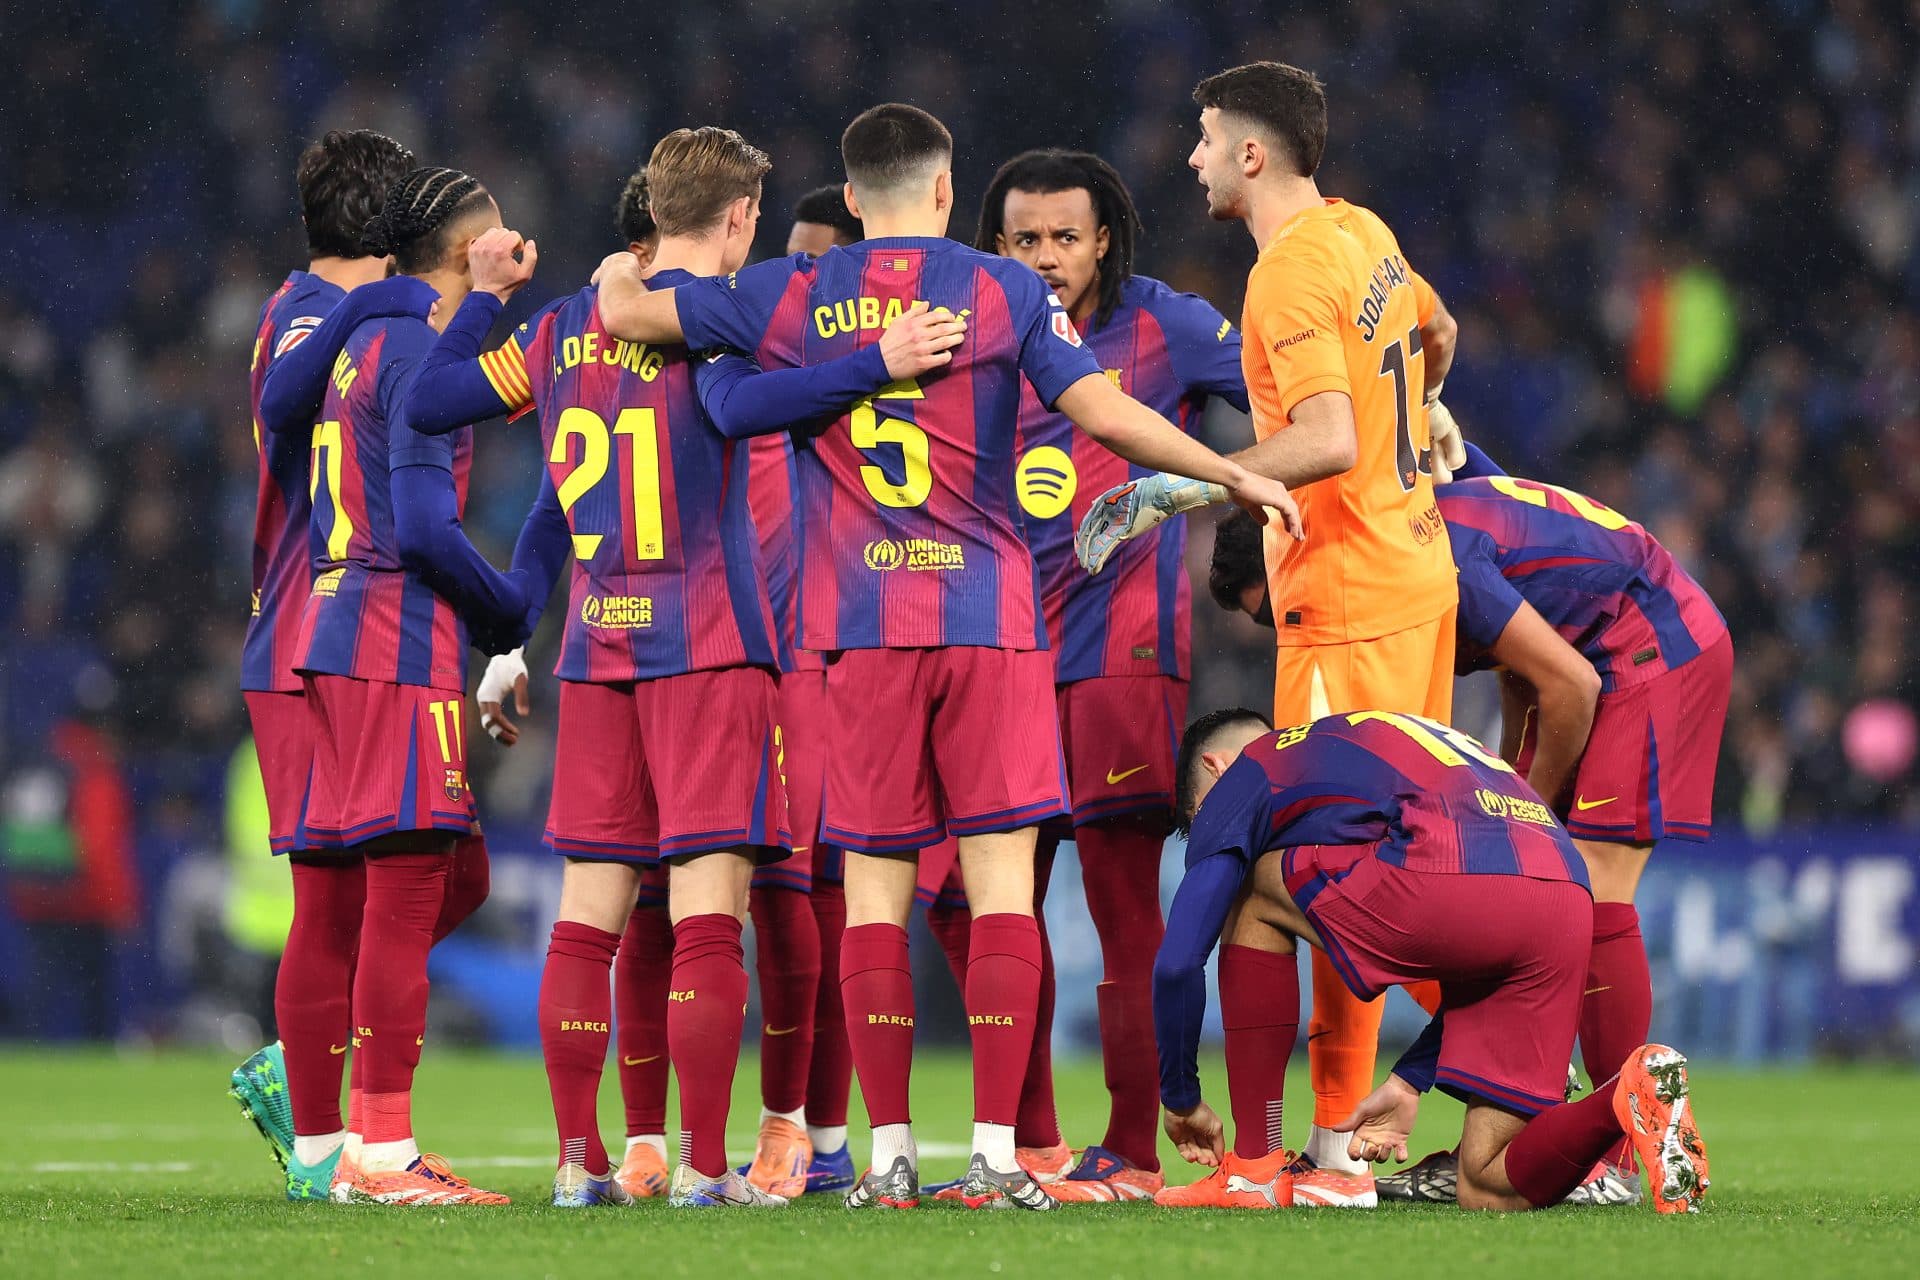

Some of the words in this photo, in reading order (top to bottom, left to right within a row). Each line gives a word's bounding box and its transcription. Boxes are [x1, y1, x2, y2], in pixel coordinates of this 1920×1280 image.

[814, 297, 972, 339] CUBA
[563, 332, 599, 369] DE
[602, 337, 664, 383] JNG
[850, 379, 933, 508] 5
[549, 407, 665, 561] 21
[905, 538, 963, 554] UNHCR
[907, 552, 965, 566] ACNUR
[600, 609, 653, 623] ACNUR
[429, 700, 463, 763] 11
[668, 989, 696, 1003] ARÇA
[561, 1020, 608, 1033] BARÇA
[868, 1013, 915, 1028] BARÇA
[969, 1014, 1014, 1027] BARÇA
